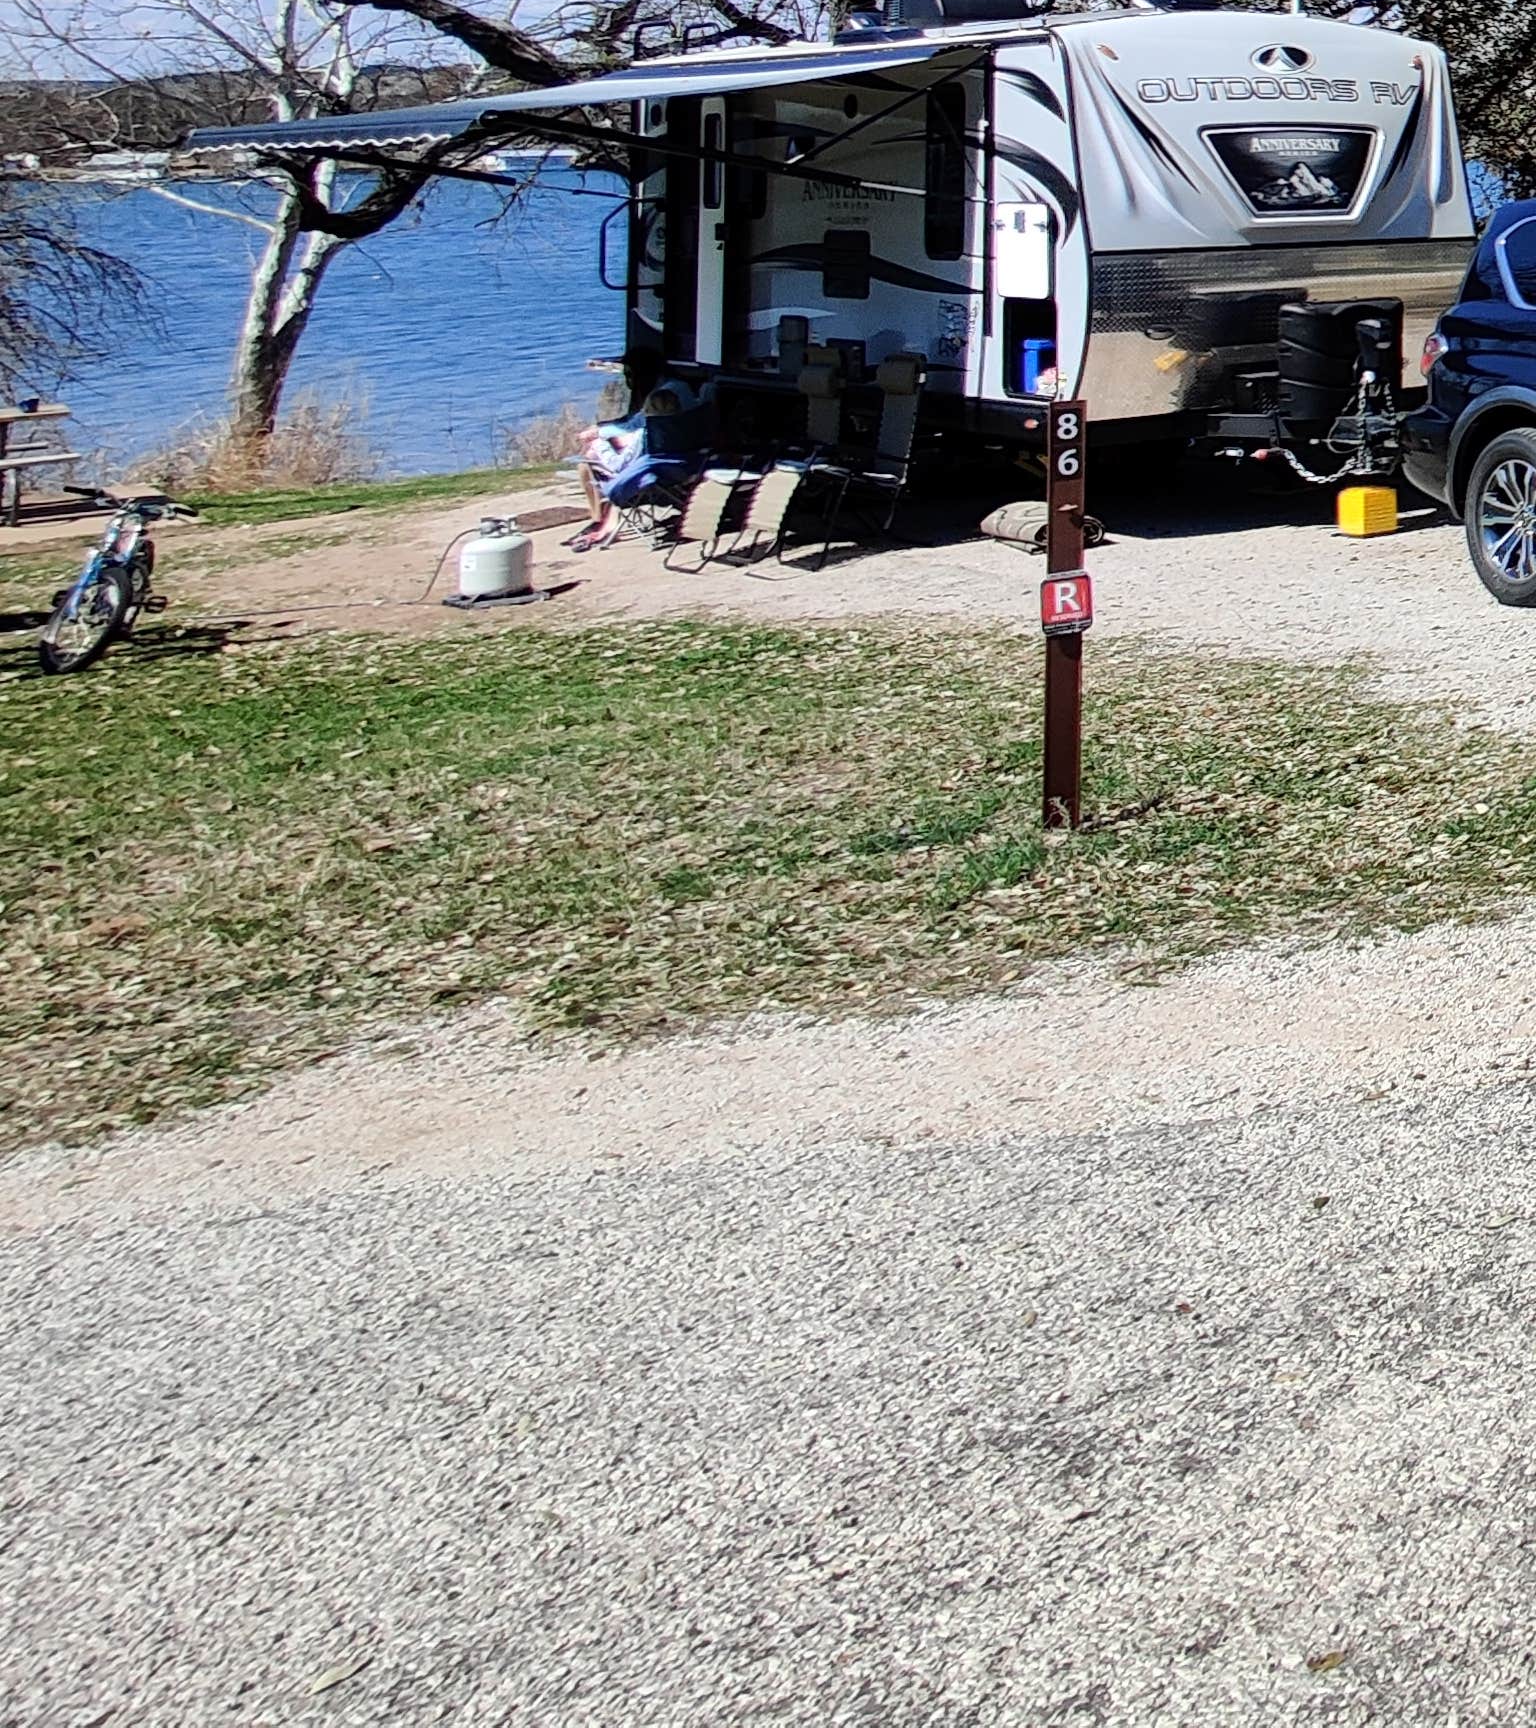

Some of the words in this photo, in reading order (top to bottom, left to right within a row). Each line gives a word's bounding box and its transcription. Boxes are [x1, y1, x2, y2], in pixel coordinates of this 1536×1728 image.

[1136, 76, 1359, 103] OUTDOORS
[1370, 81, 1419, 106] RV
[1249, 137, 1341, 153] ANNIVERSARY
[1054, 581, 1081, 614] R
